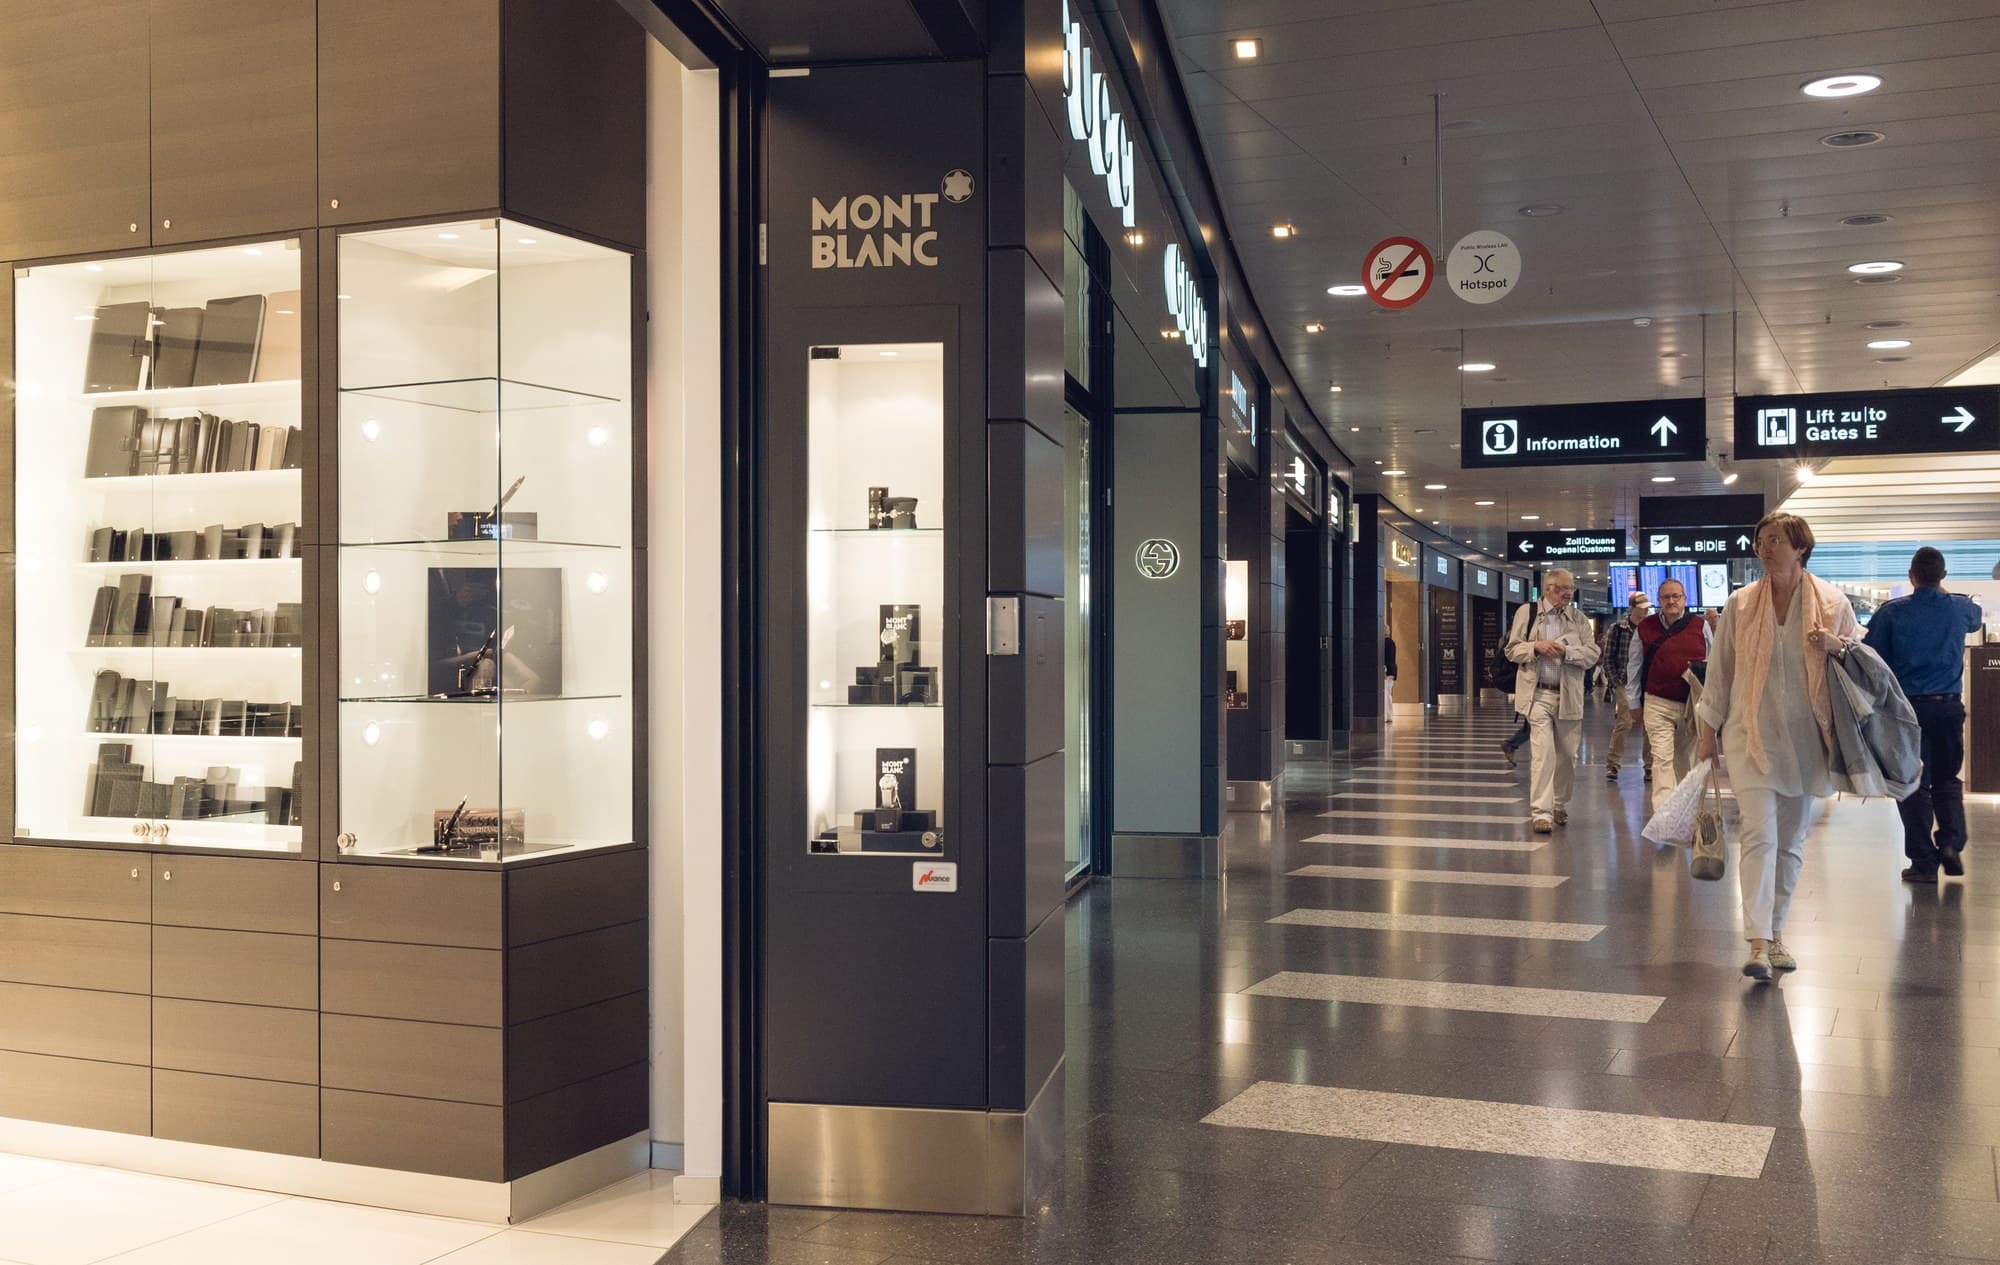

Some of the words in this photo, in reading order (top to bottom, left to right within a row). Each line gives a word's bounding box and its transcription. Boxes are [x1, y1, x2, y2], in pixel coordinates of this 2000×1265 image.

[811, 193, 939, 231] MONT
[811, 231, 938, 269] BLANC
[1460, 278, 1507, 290] Hotspot
[1806, 409, 1835, 424] Lift
[1806, 426, 1858, 441] Gates
[1866, 424, 1878, 439] E
[1526, 435, 1620, 451] Information
[885, 616, 907, 624] MONT
[881, 760, 904, 768] MONT
[918, 869, 950, 886] Nuance
